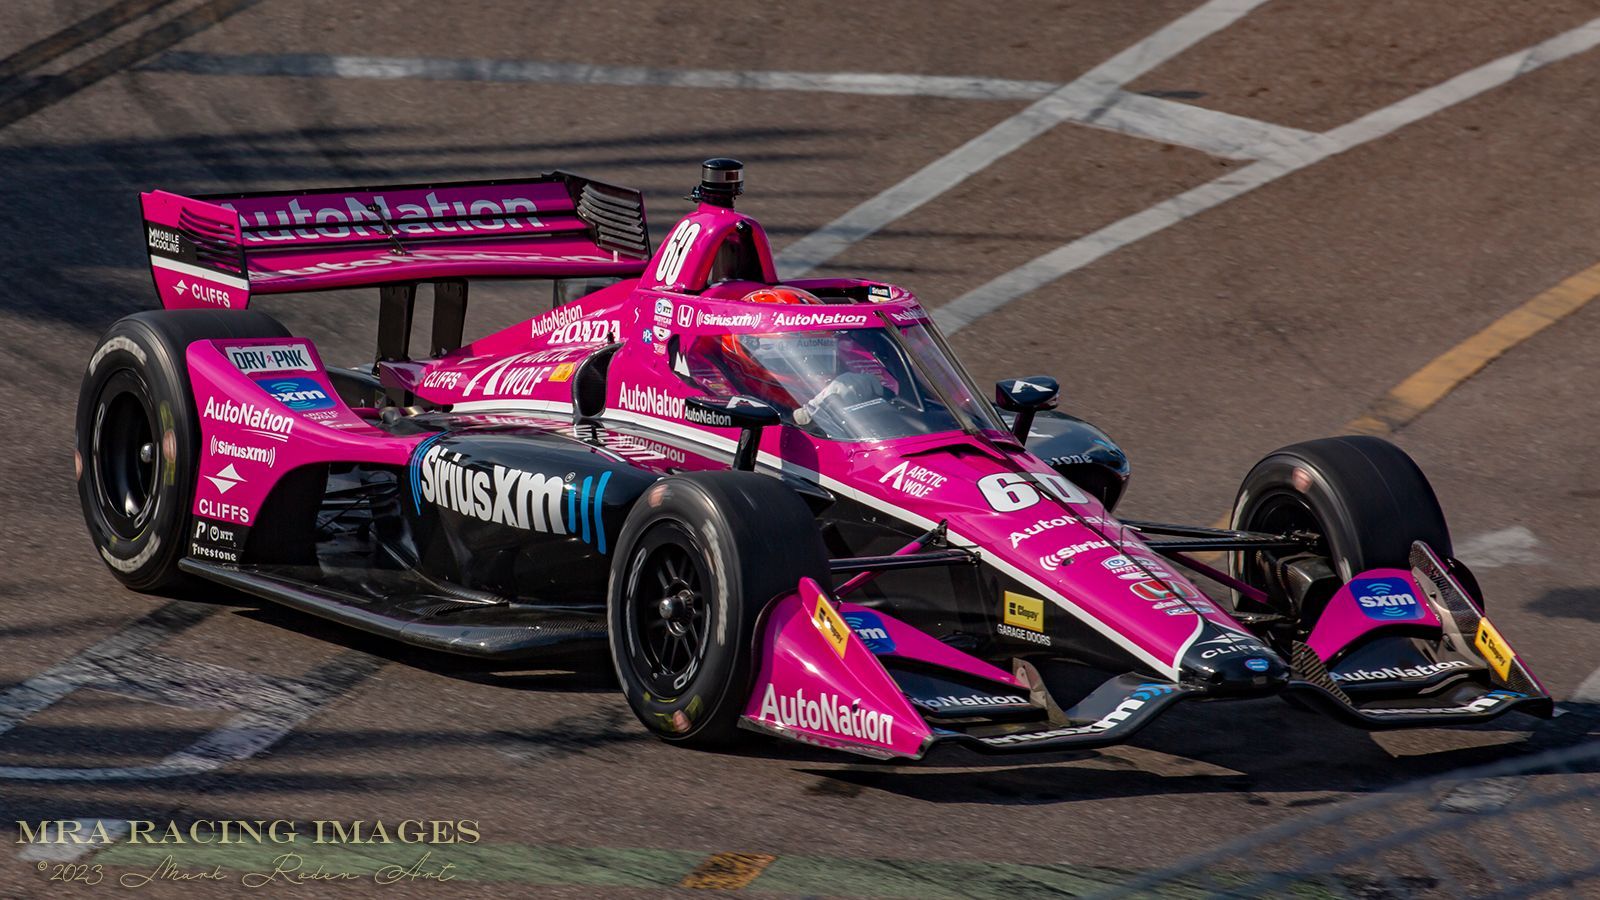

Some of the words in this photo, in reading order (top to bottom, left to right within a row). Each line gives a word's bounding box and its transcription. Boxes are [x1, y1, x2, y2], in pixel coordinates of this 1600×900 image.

[154, 228, 180, 244] MOBILE
[155, 239, 180, 253] COOLING
[656, 219, 701, 286] 60
[191, 283, 231, 309] CLIFFS
[531, 304, 583, 338] AutoNation
[773, 311, 868, 326] AutoNation
[547, 320, 621, 344] HONDA
[233, 350, 267, 370] DRV
[271, 349, 309, 367] PNK
[423, 370, 462, 390] CLIFFS
[499, 366, 553, 396] WOLF
[203, 395, 294, 434] AutoNation
[684, 405, 732, 427] AutoNation
[906, 465, 948, 488] ARCTIC
[901, 481, 934, 498] WOLF
[976, 471, 1089, 513] 60
[199, 498, 250, 523] CLIFFS
[192, 542, 237, 561] Firestone
[1358, 592, 1416, 608] sxm
[1017, 605, 1040, 623] Clopay
[997, 623, 1026, 641] GARAGE
[1026, 630, 1051, 647] DOORS
[1329, 660, 1471, 683] AutoNation
[758, 682, 894, 745] AutoNation
